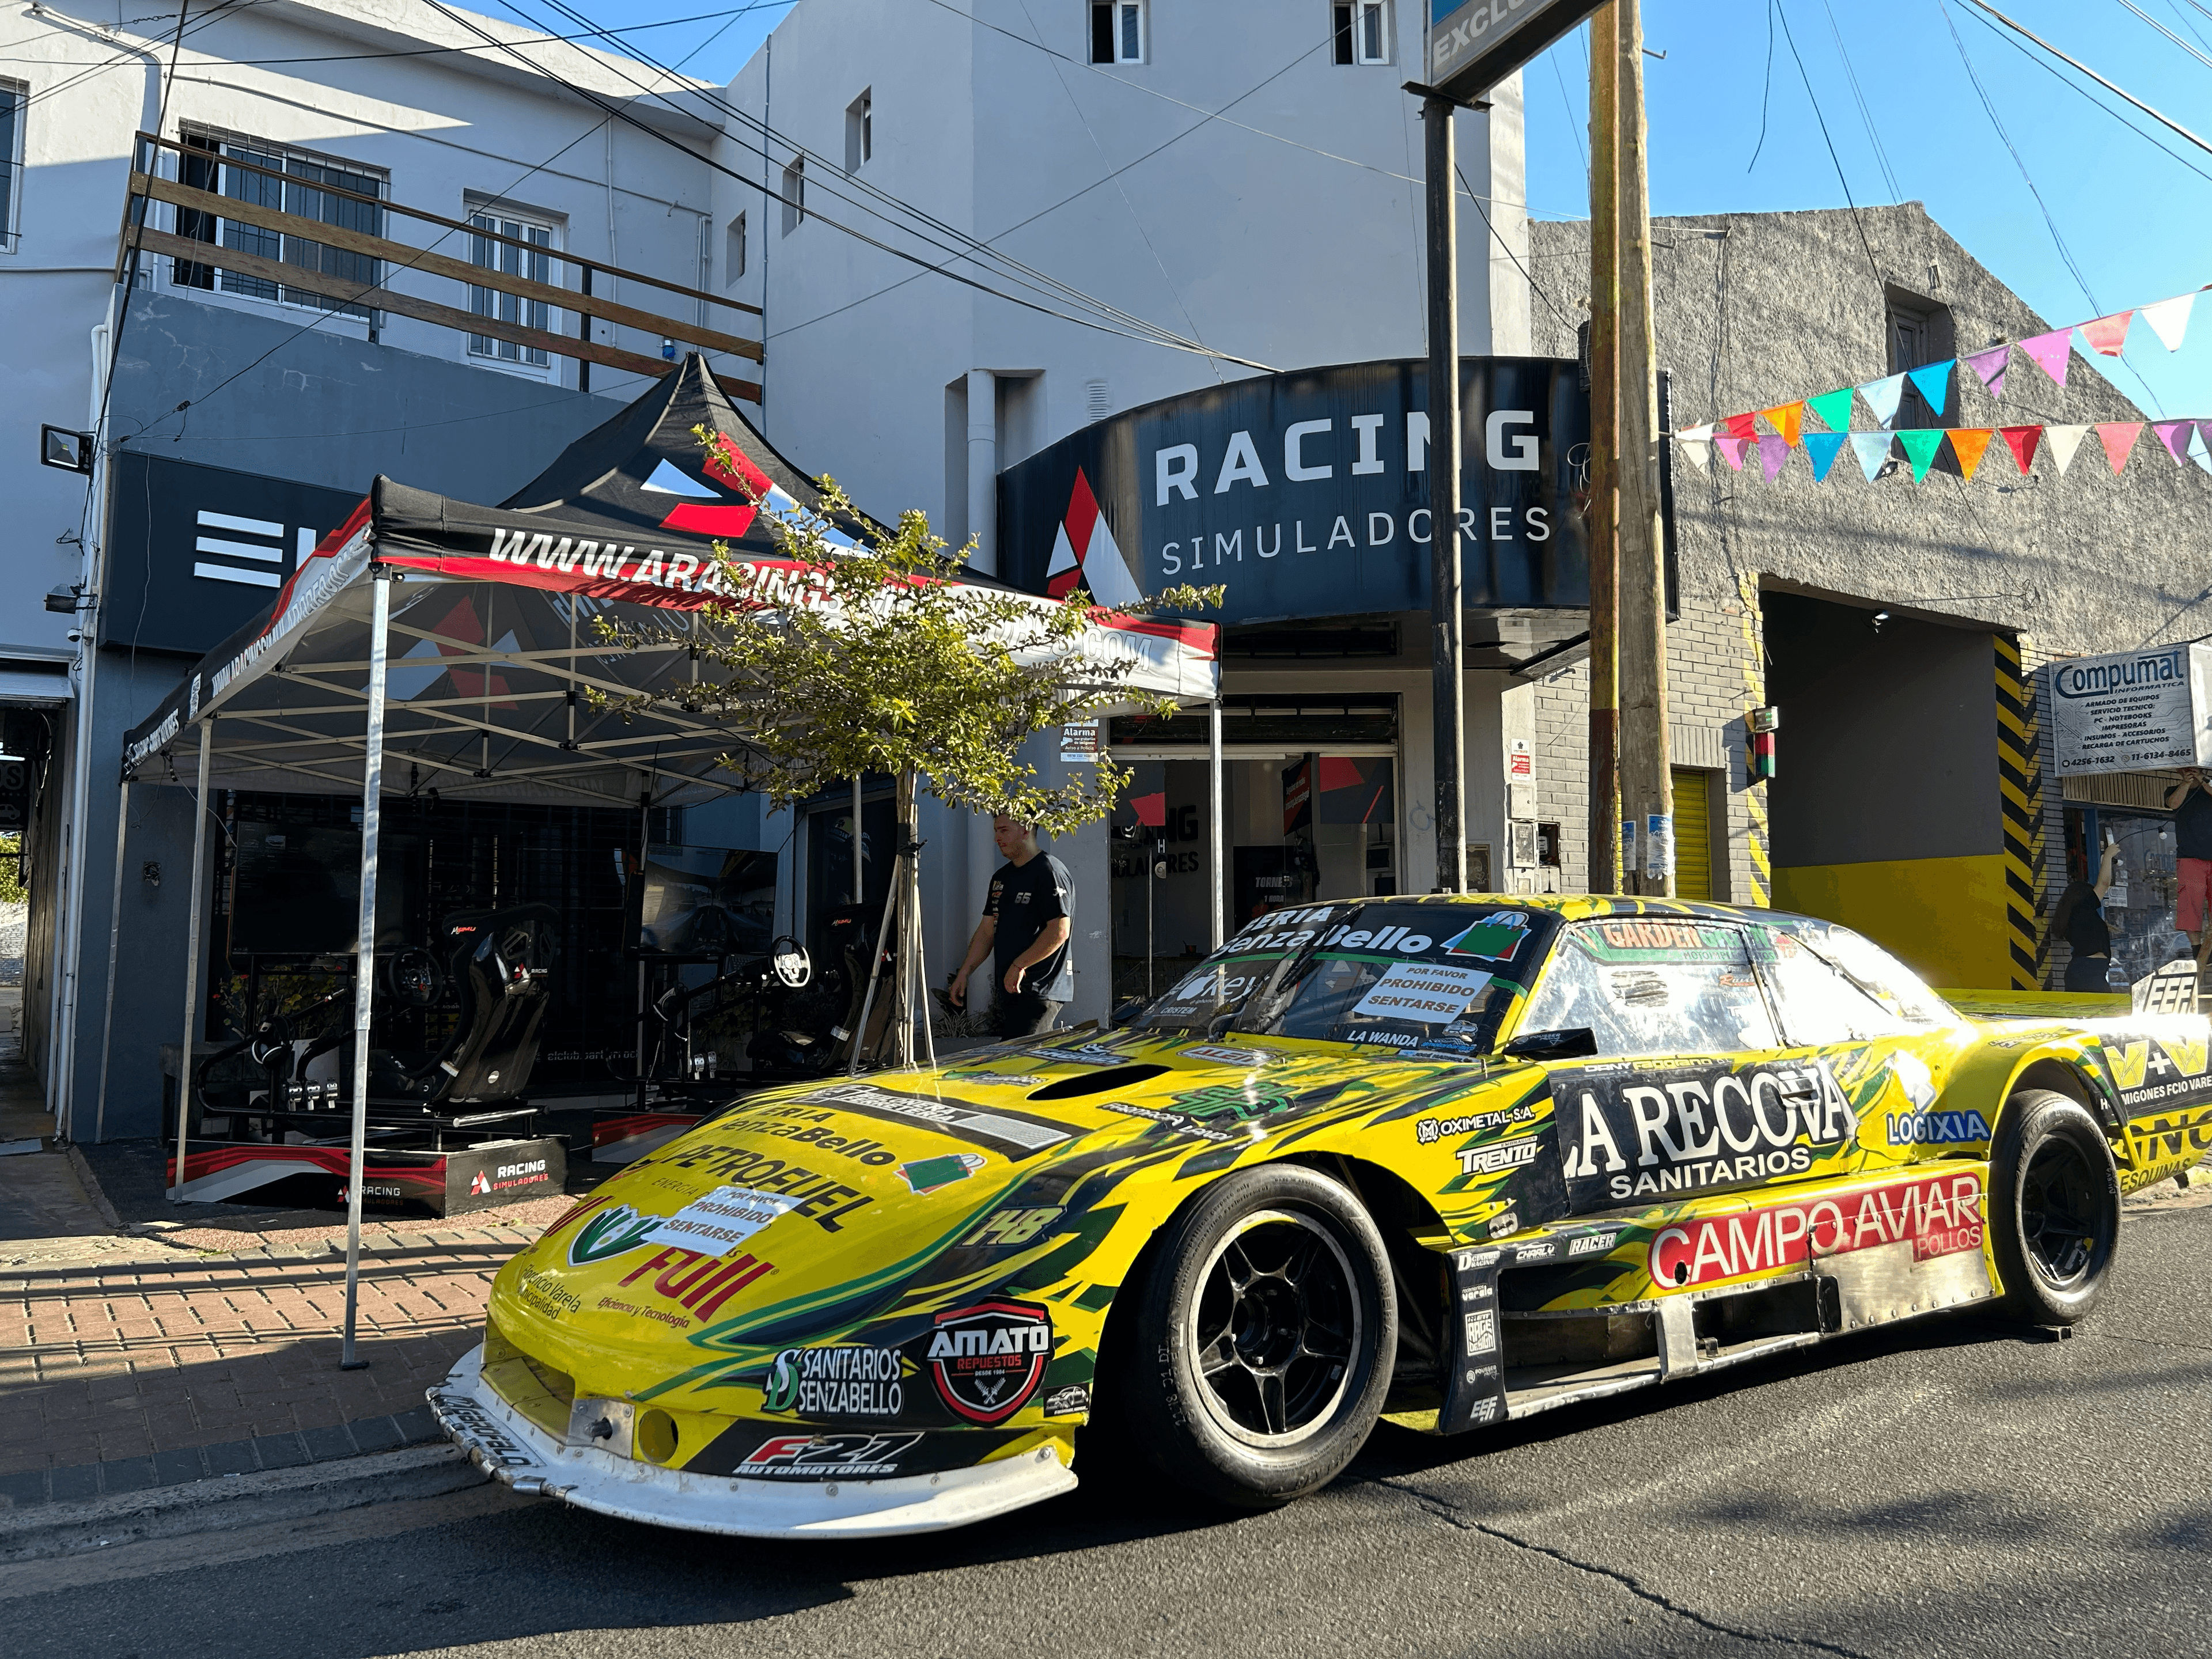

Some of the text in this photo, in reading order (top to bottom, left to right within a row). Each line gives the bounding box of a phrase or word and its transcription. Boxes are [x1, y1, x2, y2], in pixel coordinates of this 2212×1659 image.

[2114, 681, 2184, 694] INFORMATICA
[2085, 699, 2116, 708] ARMADO
[2129, 694, 2160, 703] EQUIPOS
[2090, 707, 2121, 715] SERVICIO
[2108, 712, 2152, 722] NOTEBOOKS
[1063, 728, 1096, 736] Alarma
[2084, 728, 2166, 741] INSUMOS ACCESORIOS
[2102, 721, 2147, 731] IMPRESORAS
[2082, 741, 2113, 749] RECARGA
[2126, 736, 2169, 745] CARTUCHOS
[2071, 749, 2191, 766] 4256-1632 11-6134-8465
[1406, 968, 1468, 979] POR FAVOR
[1378, 978, 1475, 997] PROHIBIDO
[1368, 995, 1460, 1013] SENTARSE
[1347, 1030, 1366, 1042] LA
[1368, 1031, 1419, 1048] WANDA
[1585, 1062, 1631, 1073] DANY
[1632, 1058, 1713, 1070] Faggiano
[2166, 1081, 2188, 1096] FCIO
[1440, 1111, 1512, 1135] OXIMETAL
[1888, 1109, 1990, 1145] LOGIXIA
[1501, 1136, 1536, 1147] EMBRAGUES
[1456, 1142, 1538, 1176] TRENTO
[497, 1159, 546, 1178] RACING
[1610, 1147, 1811, 1199] SANITARIOS
[2120, 1157, 2191, 1193] ESQUINAS
[493, 1173, 548, 1191] SIMULADORES
[728, 1191, 781, 1205] POR FAVOR
[690, 1201, 775, 1225] PROHIBIDO
[663, 1218, 746, 1243] SENTARSE
[1651, 1177, 1980, 1289] CAMPO AVIAR
[1917, 1225, 1982, 1259] POLLOS
[548, 1280, 582, 1314] Varela
[597, 1296, 691, 1329] Eficiencia y Tecnología
[927, 1325, 1051, 1358] AMATO
[801, 1348, 901, 1381] SANITARIOS
[957, 1355, 1022, 1370] REPUESTOS
[799, 1382, 902, 1414] SENZABELLO
[732, 1463, 899, 1476] AUTOMOTORES
